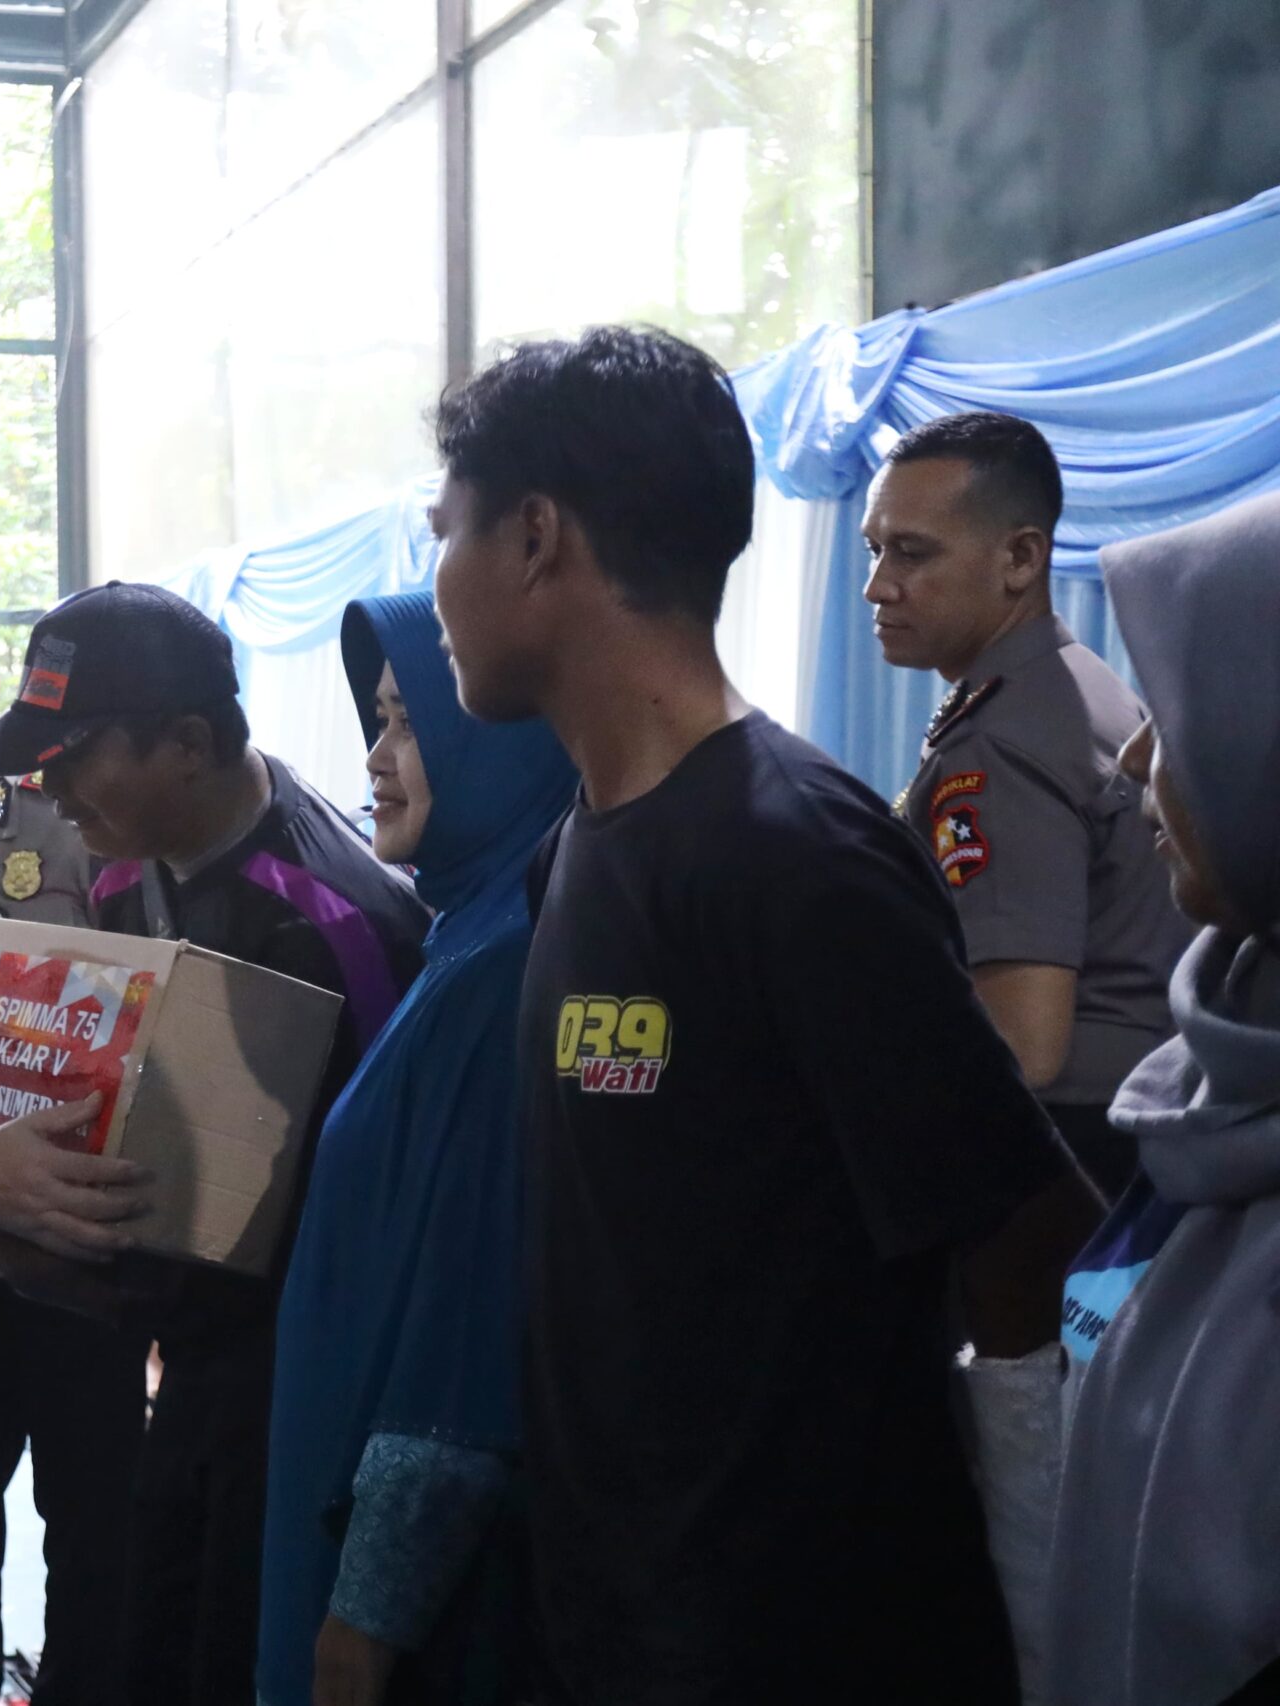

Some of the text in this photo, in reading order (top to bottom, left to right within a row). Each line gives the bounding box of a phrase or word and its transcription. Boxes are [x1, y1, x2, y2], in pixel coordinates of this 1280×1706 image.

[72, 1010, 100, 1040] 75
[556, 995, 672, 1076] 039
[52, 1048, 72, 1077] V
[581, 1057, 663, 1094] Wati
